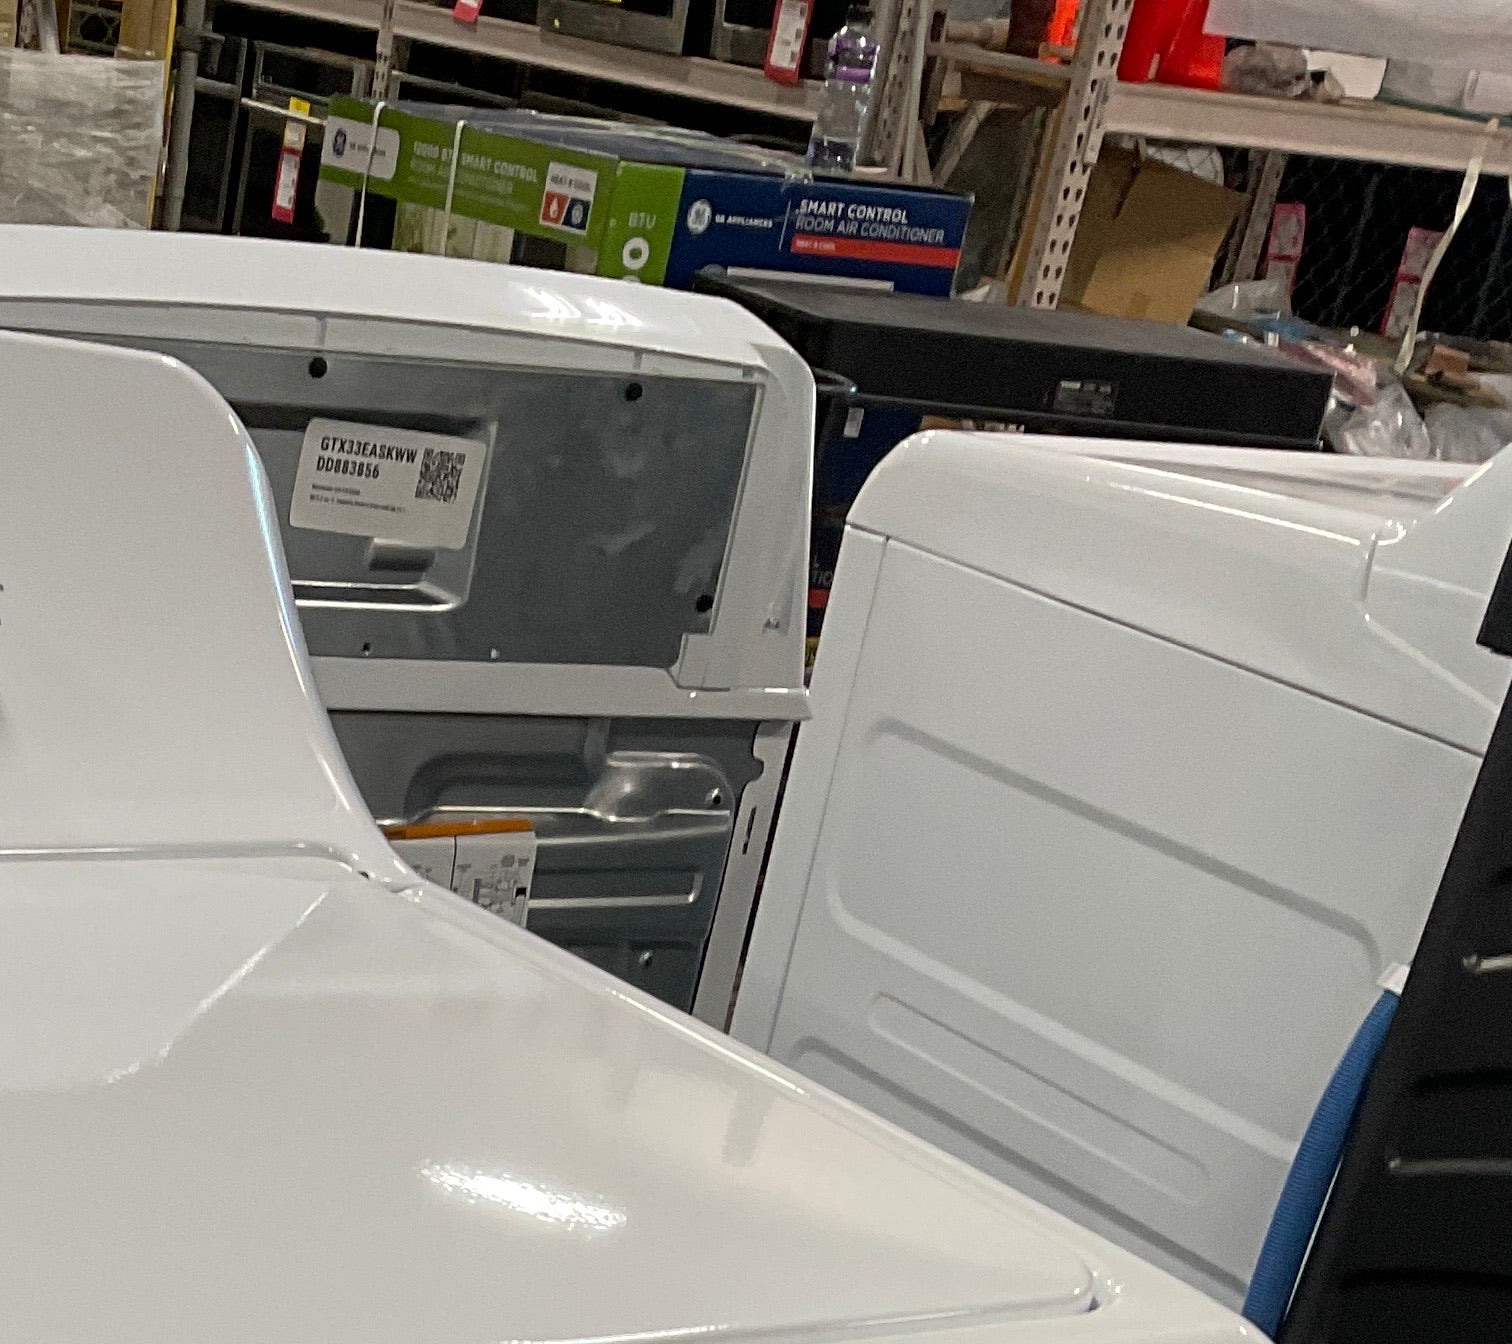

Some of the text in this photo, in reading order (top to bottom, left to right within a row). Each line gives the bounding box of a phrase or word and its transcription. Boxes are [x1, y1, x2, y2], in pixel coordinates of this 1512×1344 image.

[461, 151, 492, 172] SMART
[493, 160, 538, 183] CONTROL
[628, 211, 657, 229] BTU
[799, 199, 909, 224] SMART CONTROL
[795, 214, 945, 244] ROOM AIR CONDITIONER
